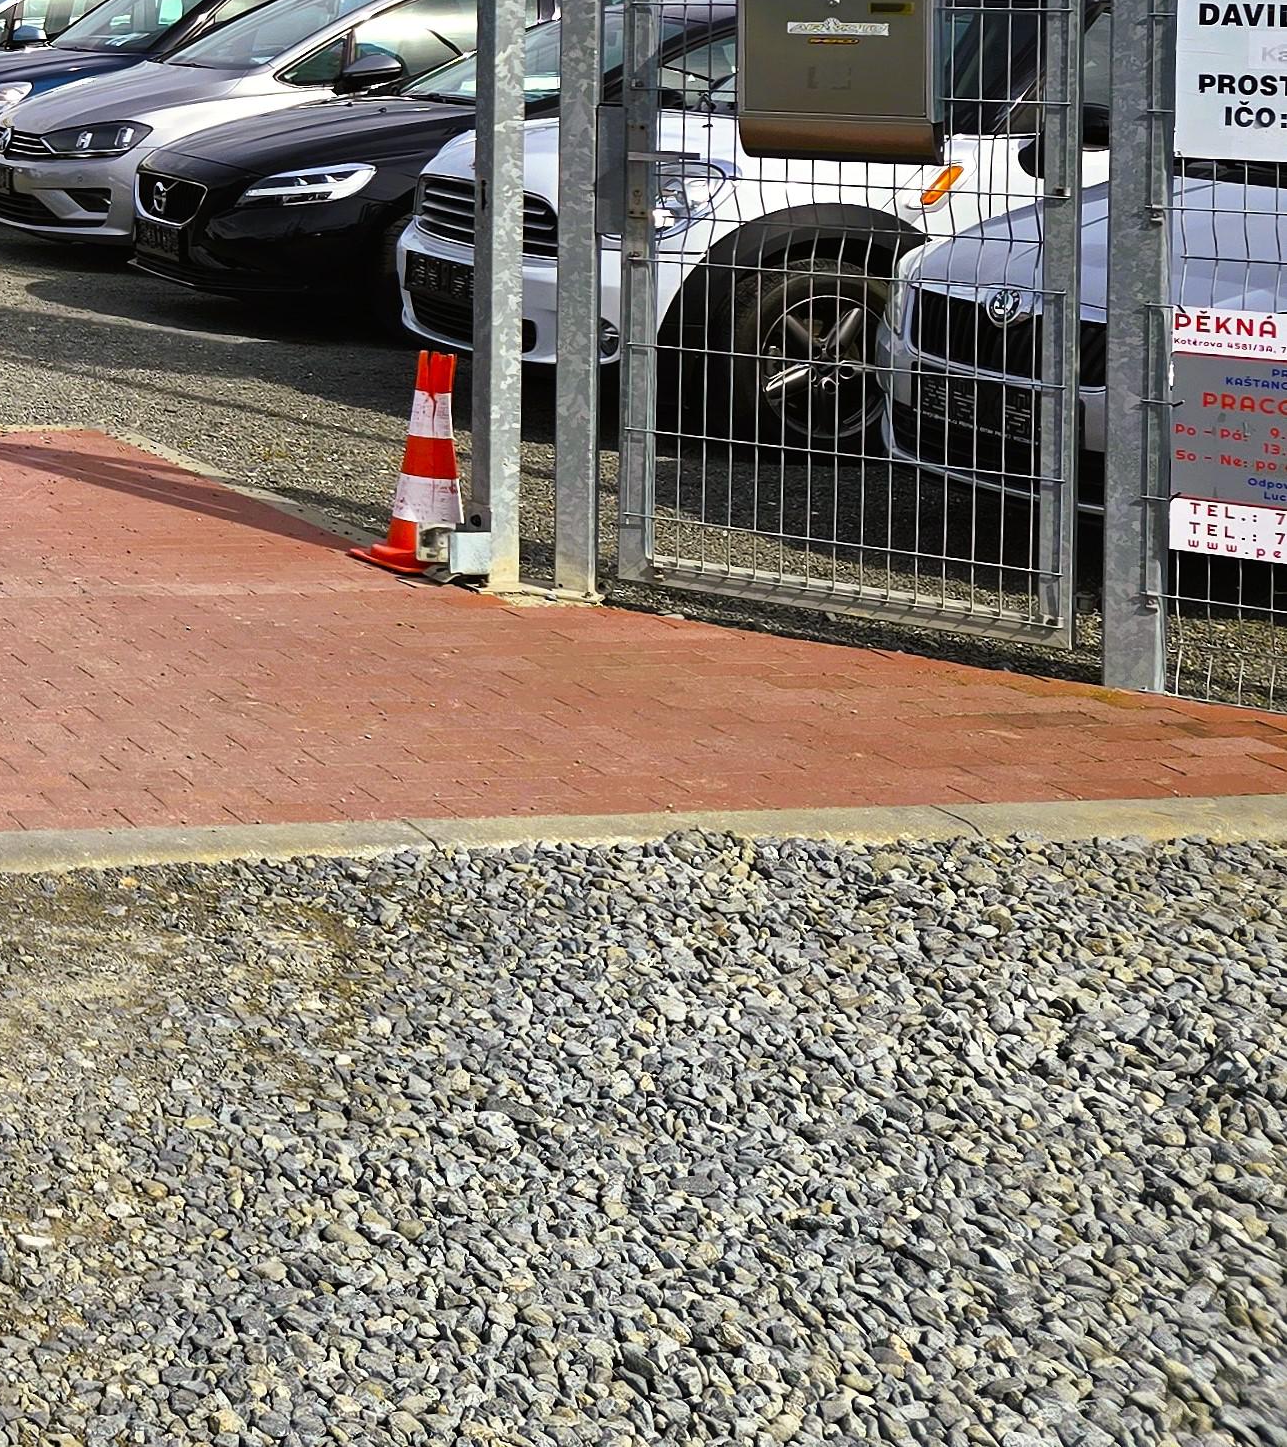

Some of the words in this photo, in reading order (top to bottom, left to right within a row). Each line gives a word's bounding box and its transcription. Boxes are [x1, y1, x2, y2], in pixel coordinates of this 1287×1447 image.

[1224, 100, 1287, 129] IČO:
[1174, 310, 1277, 339] PĚKNÁ
[1175, 423, 1196, 436] Po
[1175, 449, 1197, 461] So
[1220, 454, 1248, 468] Ne:
